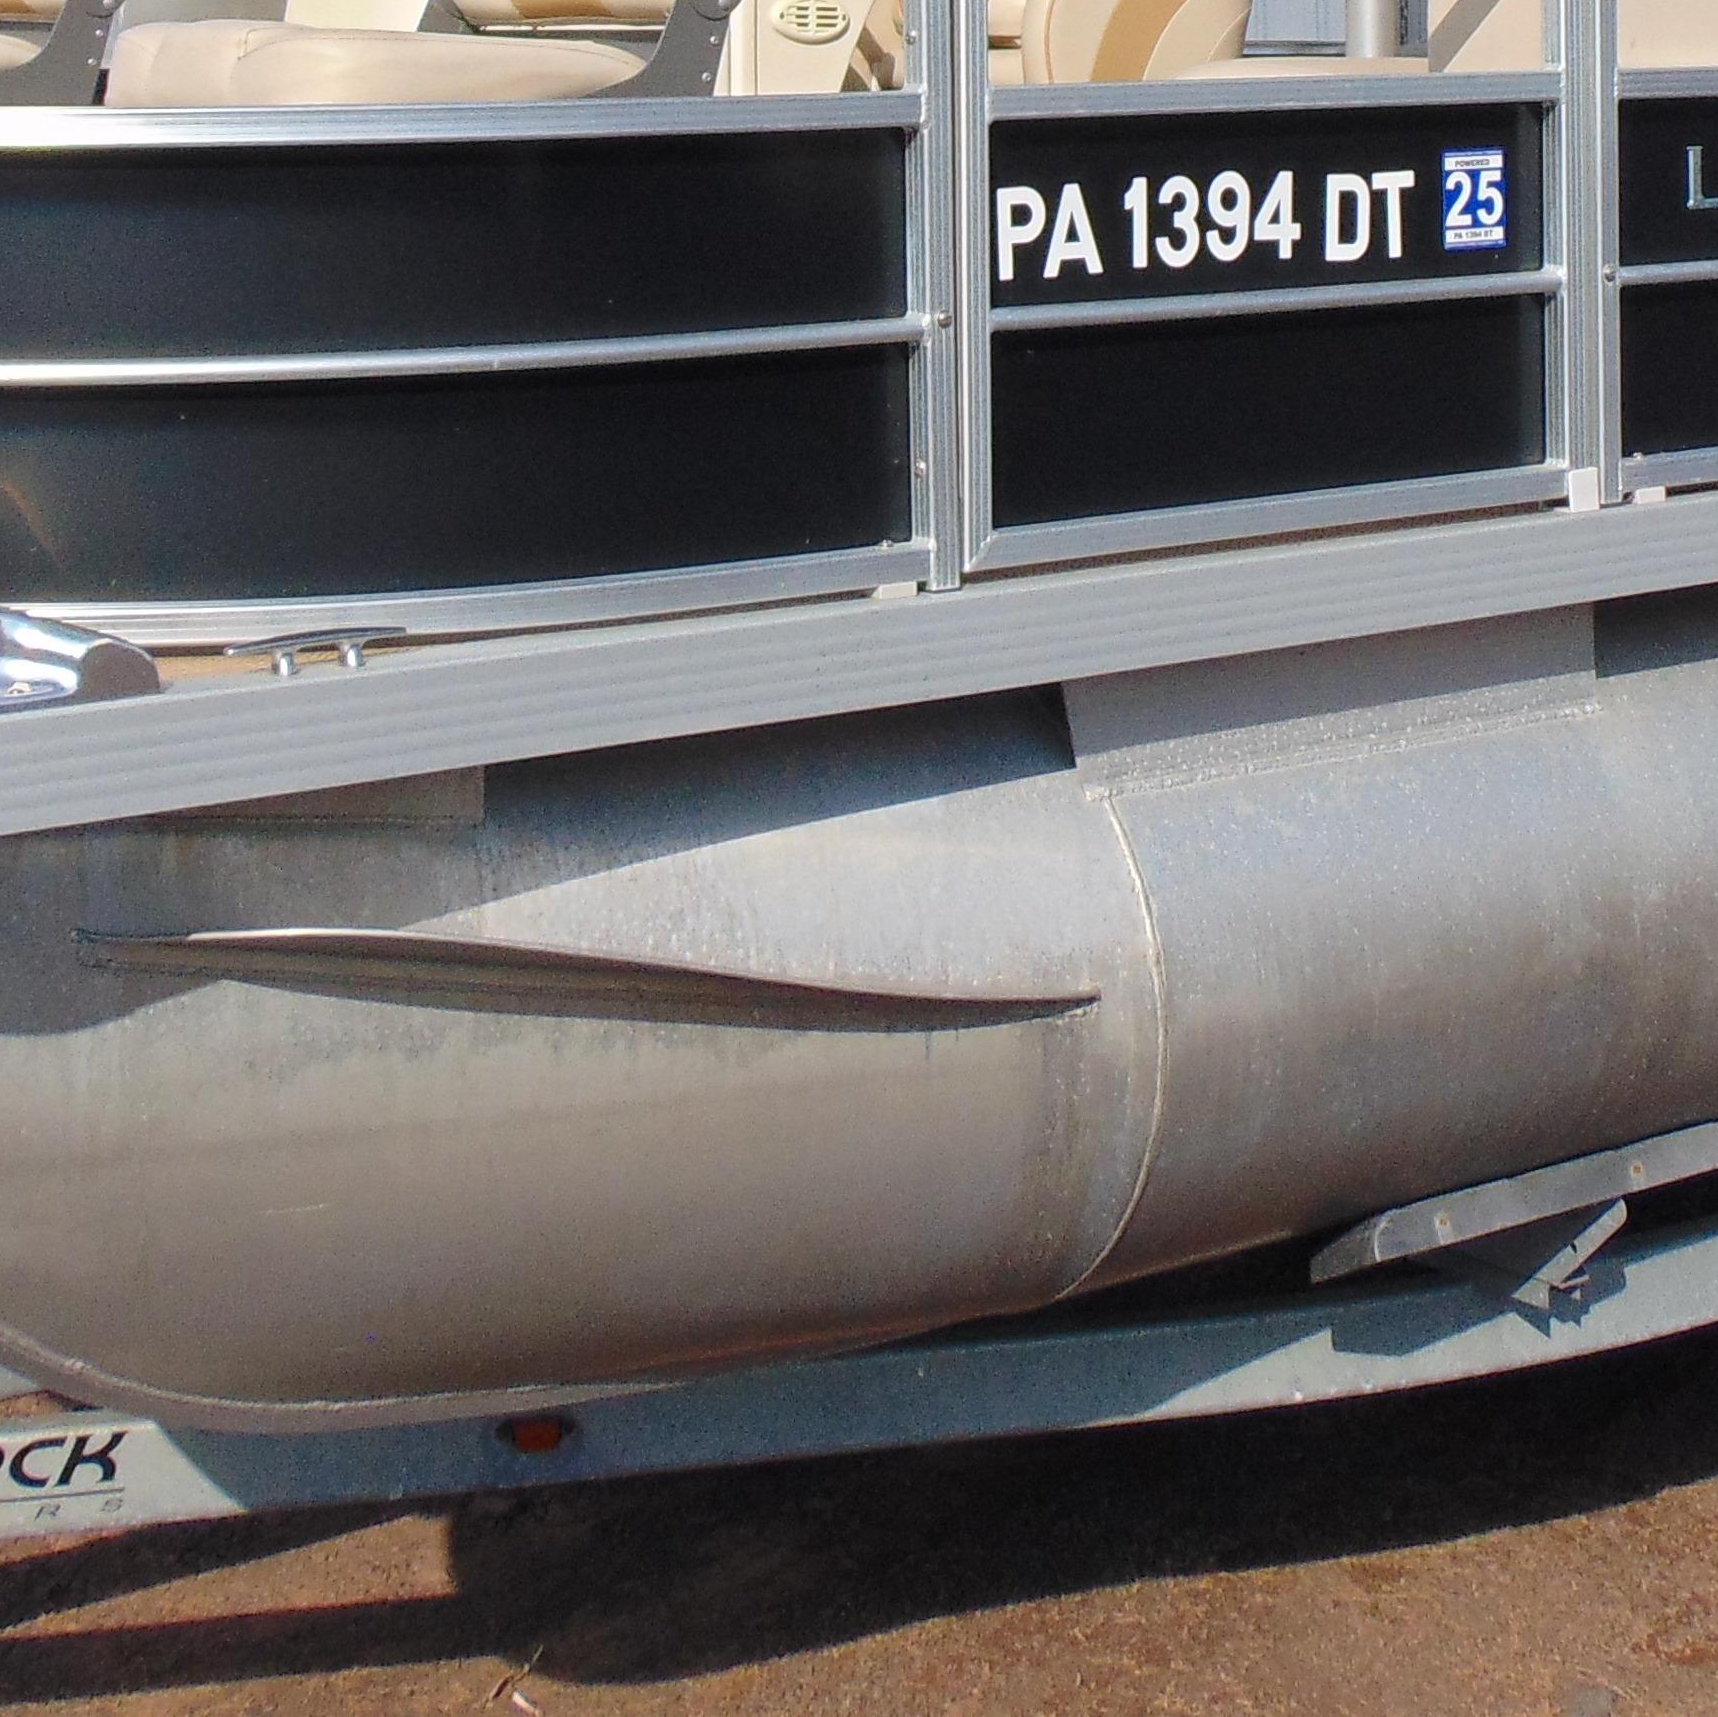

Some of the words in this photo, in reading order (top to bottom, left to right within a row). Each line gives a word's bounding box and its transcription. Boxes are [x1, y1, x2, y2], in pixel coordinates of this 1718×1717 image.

[996, 183, 1104, 282] PA
[1123, 170, 1302, 269] 1394
[1325, 170, 1415, 262] DT
[1445, 170, 1504, 227] 25
